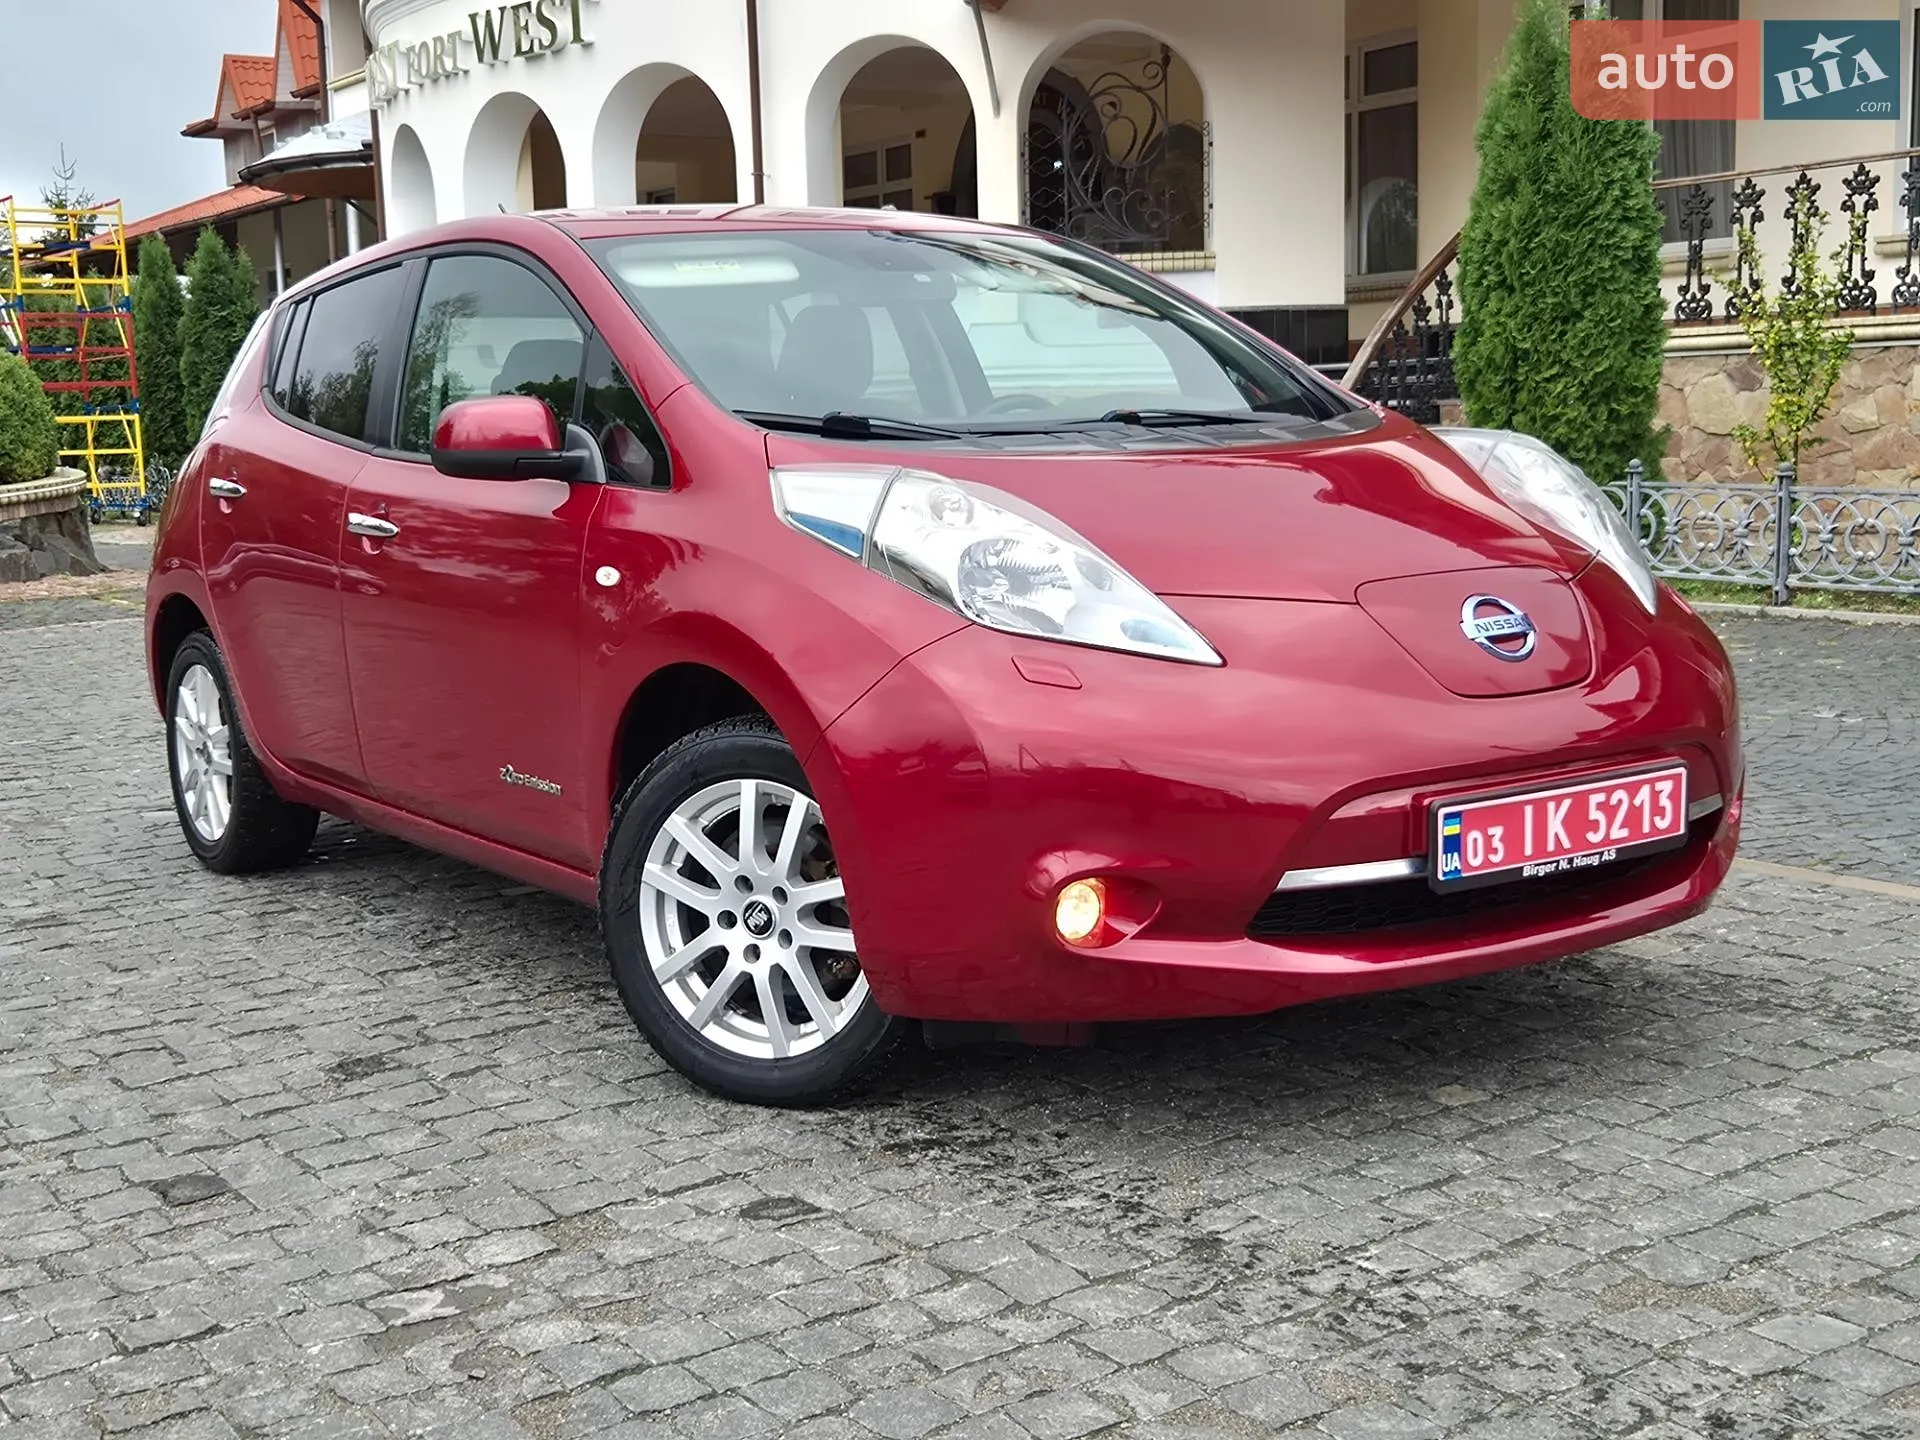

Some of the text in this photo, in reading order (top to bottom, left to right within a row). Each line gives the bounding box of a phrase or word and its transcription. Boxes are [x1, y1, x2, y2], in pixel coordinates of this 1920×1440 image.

[406, 31, 463, 84] FORT
[468, 0, 585, 64] WEST
[1466, 826, 1504, 867] 03
[1585, 779, 1674, 844] 5213
[1442, 853, 1461, 872] UA
[1522, 849, 1616, 877] Birger N. Haug AS
